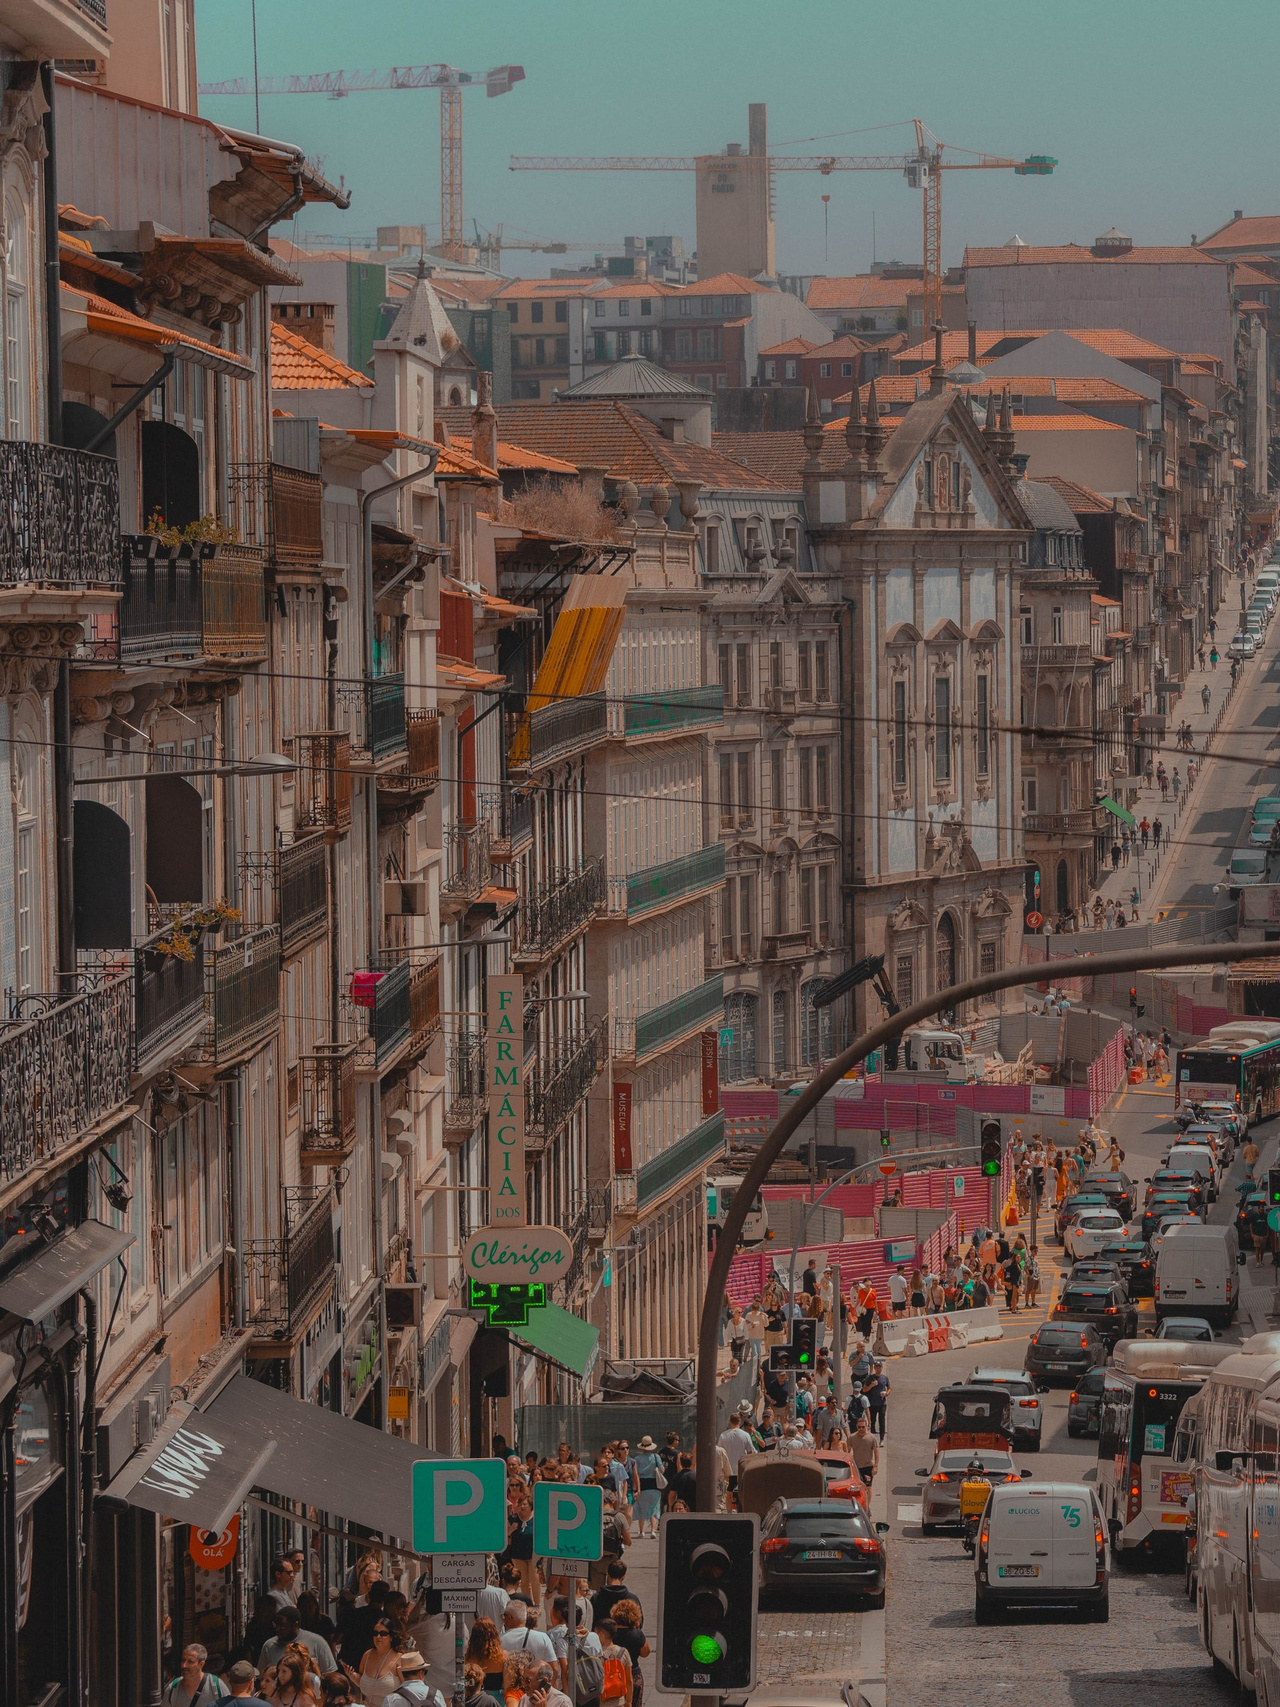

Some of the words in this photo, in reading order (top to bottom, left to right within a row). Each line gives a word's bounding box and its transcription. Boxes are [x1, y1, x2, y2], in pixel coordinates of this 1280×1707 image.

[493, 991, 519, 1196] FARMÁCIA
[618, 1092, 627, 1131] MUSEUM
[495, 1207, 521, 1219] DOS
[471, 1242, 566, 1275] Clérigos
[1159, 1393, 1178, 1401] 3322
[433, 1469, 485, 1544] P
[963, 1500, 986, 1508] Glovo
[1015, 1508, 1041, 1516] LUCIOS
[1061, 1505, 1081, 1528] 75
[548, 1490, 587, 1550] P
[202, 1547, 224, 1558] OLÁ
[441, 1559, 476, 1568] CARGAS
[561, 1562, 578, 1573] TÁXIS
[456, 1568, 462, 1577] E
[433, 1576, 484, 1585] DESCARGAS
[443, 1593, 475, 1602] MÁXIMO
[447, 1602, 470, 1610] 15min
